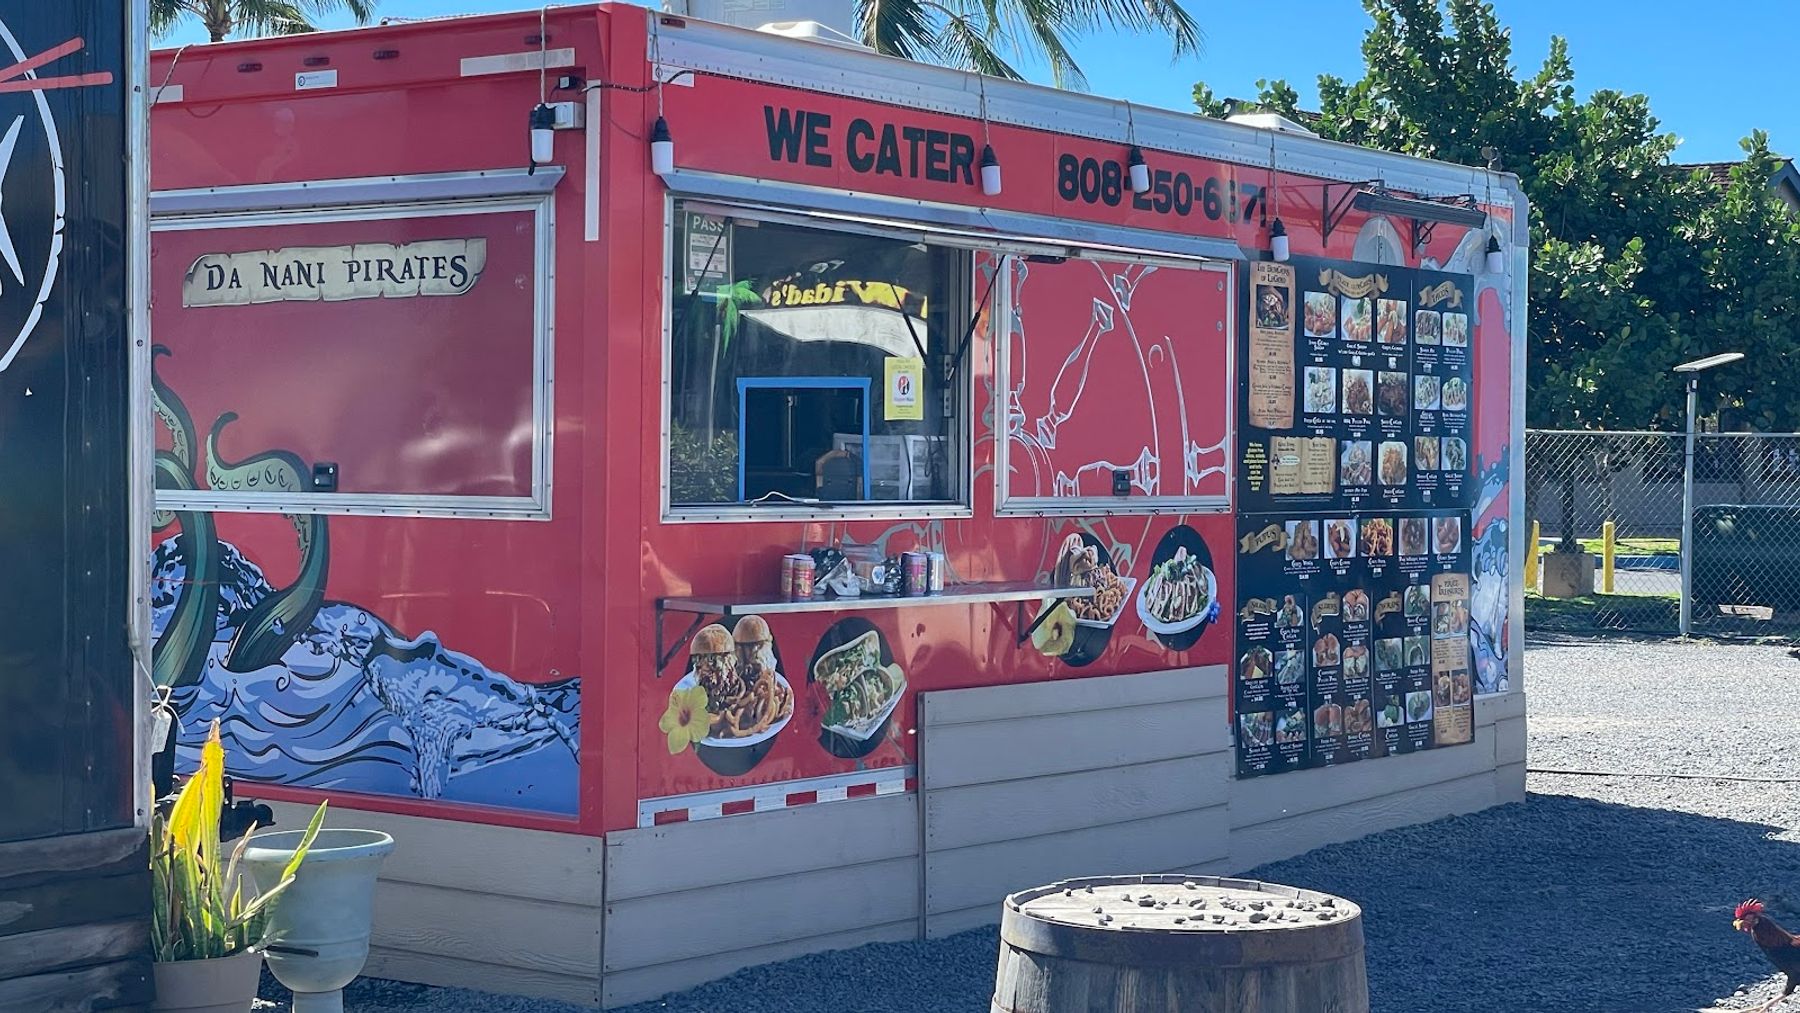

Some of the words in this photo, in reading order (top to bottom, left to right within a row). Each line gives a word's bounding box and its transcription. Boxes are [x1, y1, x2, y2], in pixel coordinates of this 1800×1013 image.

[765, 105, 832, 167] WE
[846, 117, 975, 186] CATER
[204, 263, 242, 291] DA
[260, 260, 325, 290] NANI
[343, 255, 469, 288] PIRATES
